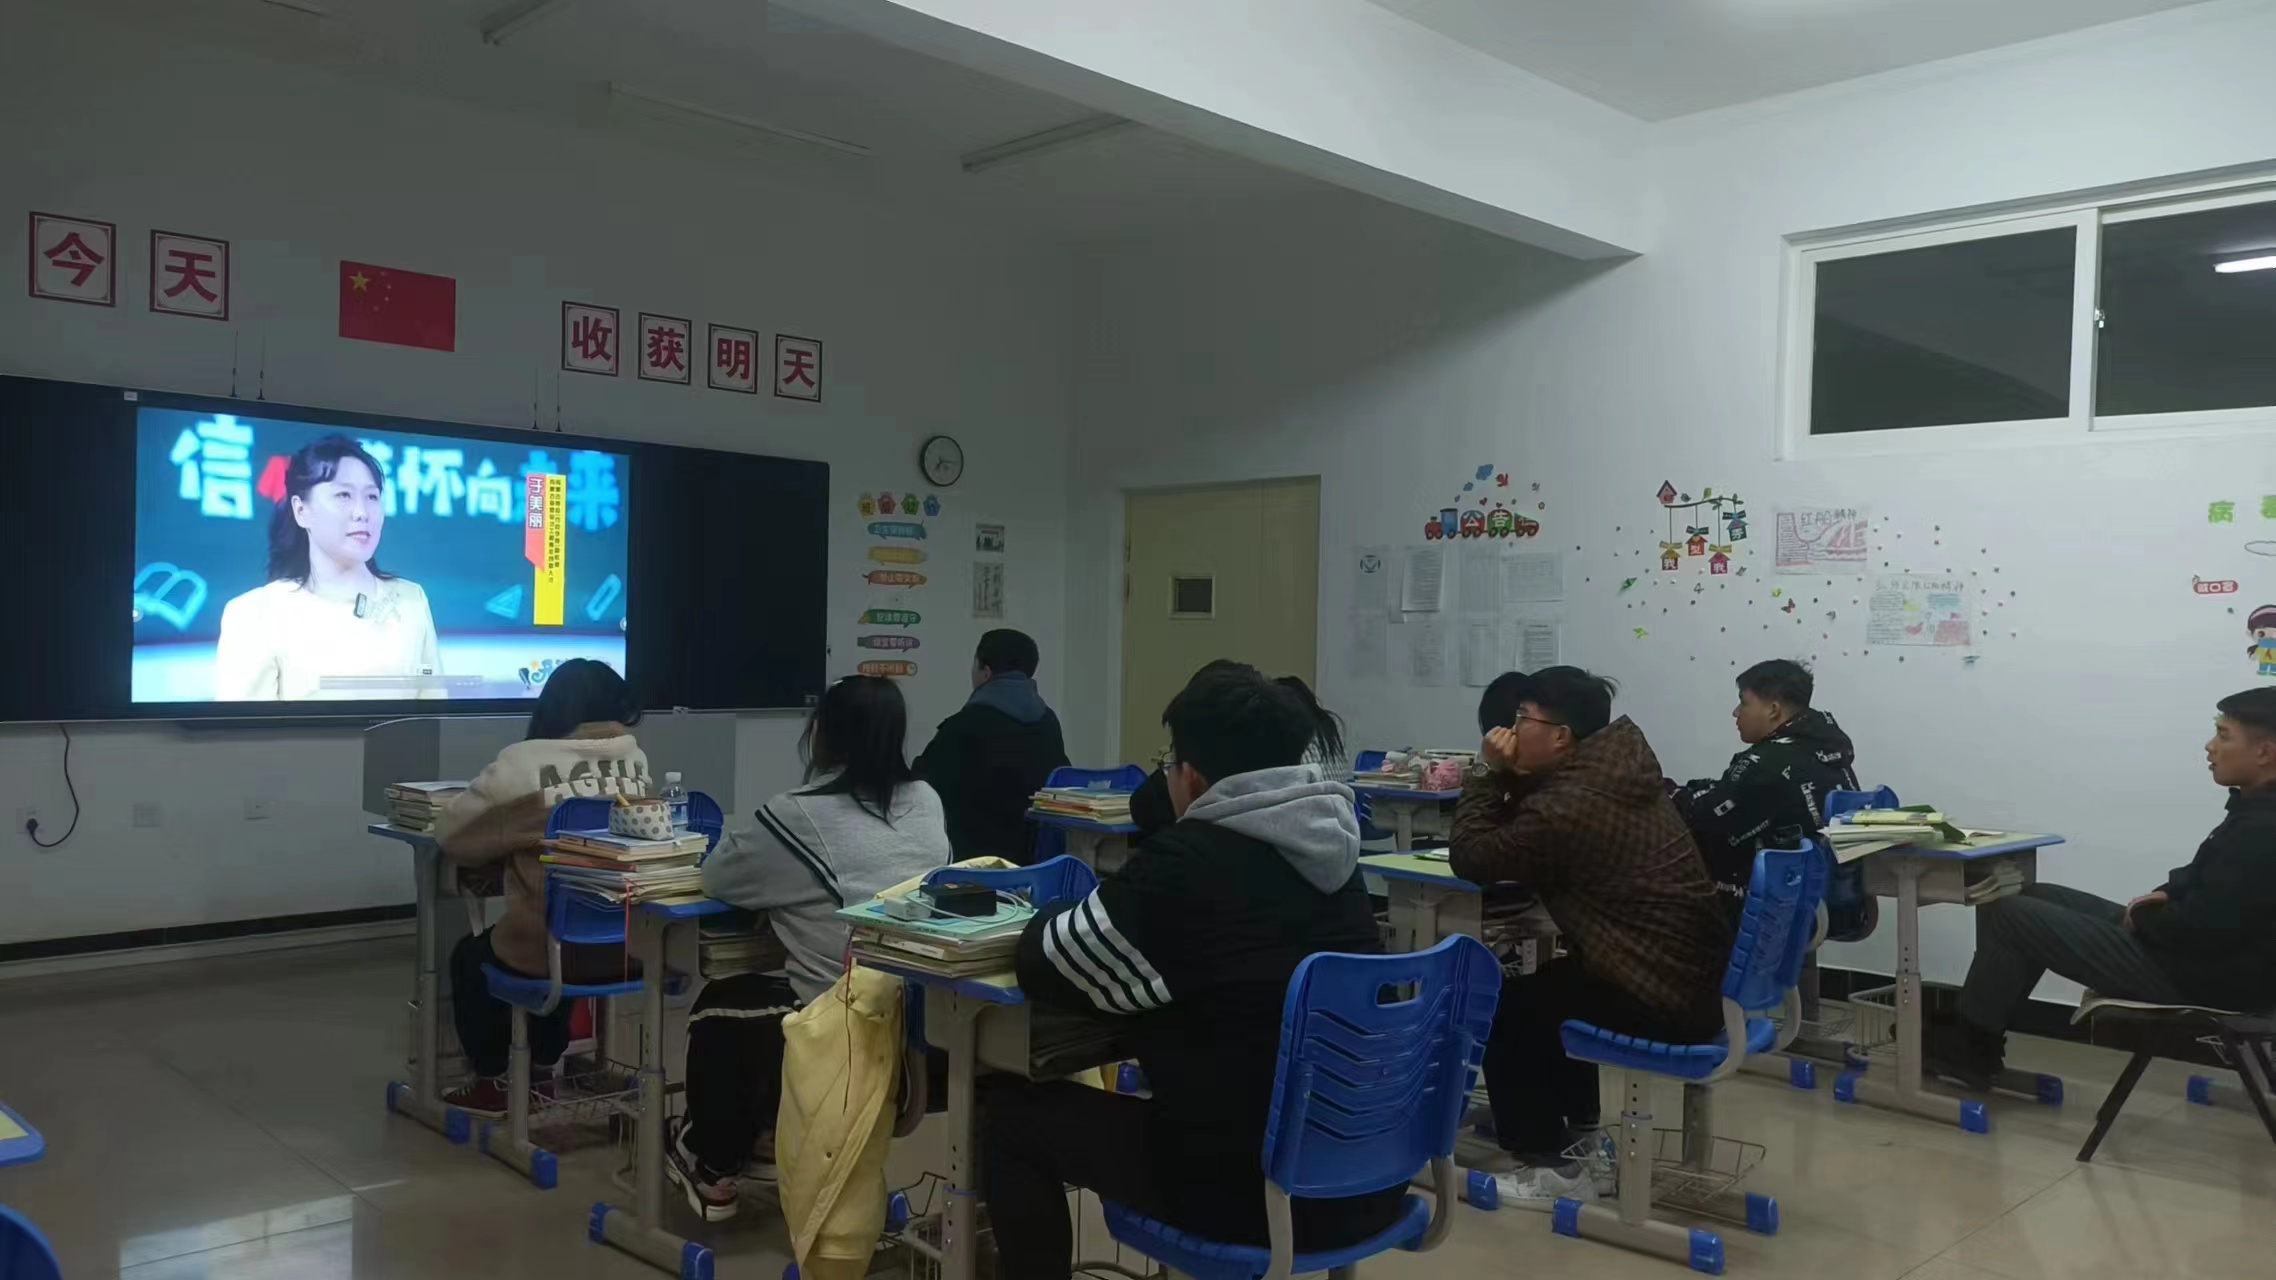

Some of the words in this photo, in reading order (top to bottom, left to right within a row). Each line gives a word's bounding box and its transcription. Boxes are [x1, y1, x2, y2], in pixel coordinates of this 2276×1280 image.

[43, 231, 218, 303] 今天
[571, 315, 815, 388] 收获明天
[529, 477, 544, 528] 于美丽
